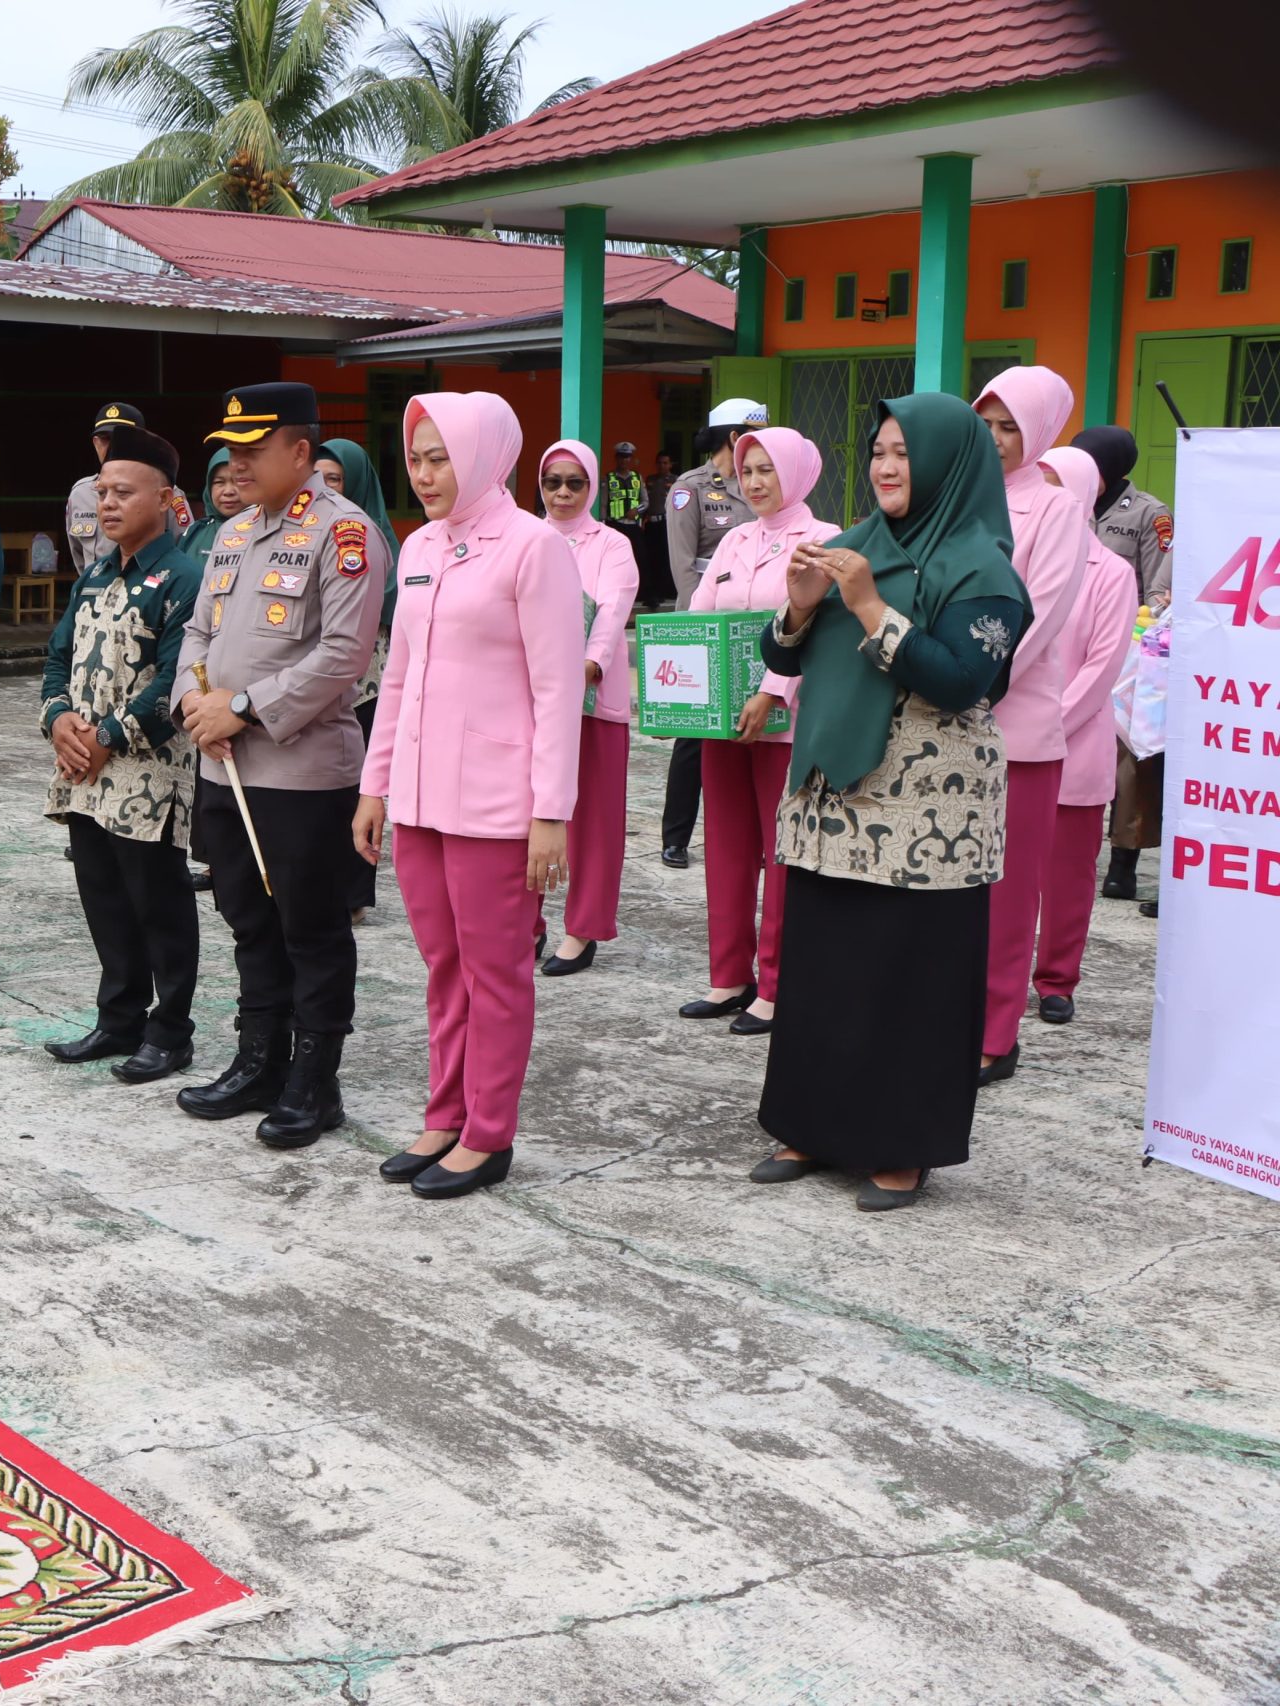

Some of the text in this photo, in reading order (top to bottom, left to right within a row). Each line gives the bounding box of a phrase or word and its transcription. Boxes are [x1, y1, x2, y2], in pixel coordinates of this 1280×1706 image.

[704, 504, 732, 512] RUTH
[1106, 525, 1139, 538] POLRI
[214, 554, 240, 568] BAKTI
[268, 551, 310, 567] POLRI
[653, 659, 678, 686] 46
[1193, 674, 1280, 710] YAY
[1183, 778, 1280, 818] BHAYA
[1172, 835, 1280, 897] PED
[1152, 1119, 1207, 1146] PENGURUS
[1209, 1137, 1254, 1163] YAYASAN
[1191, 1147, 1234, 1172] CABANG
